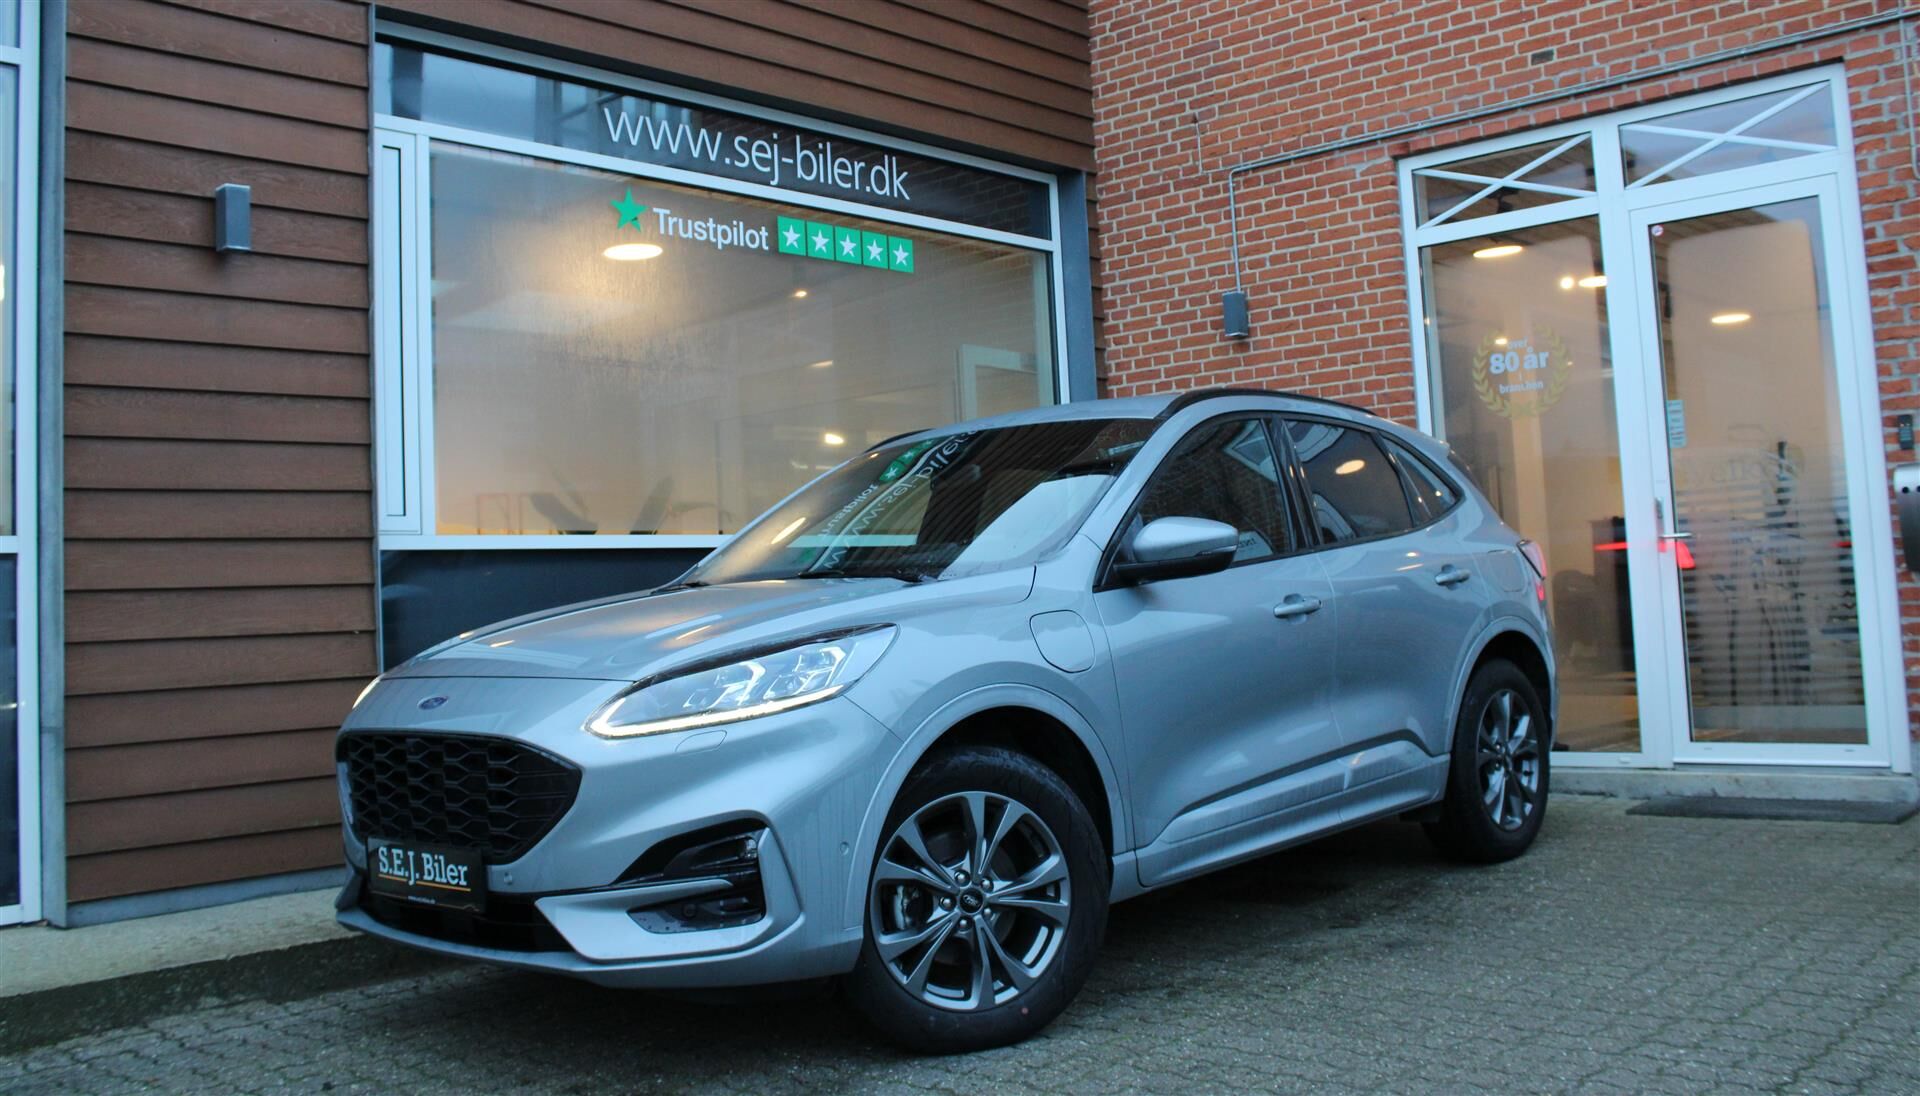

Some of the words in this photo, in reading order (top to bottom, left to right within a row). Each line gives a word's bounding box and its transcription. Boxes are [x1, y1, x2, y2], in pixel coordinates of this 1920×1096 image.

[604, 108, 910, 200] www.sej-biler.dk
[653, 207, 769, 250] Trustpilot
[1489, 352, 1520, 374] 80
[1523, 346, 1549, 369] år
[378, 847, 419, 886] S.E.J.
[422, 853, 468, 886] Biler
